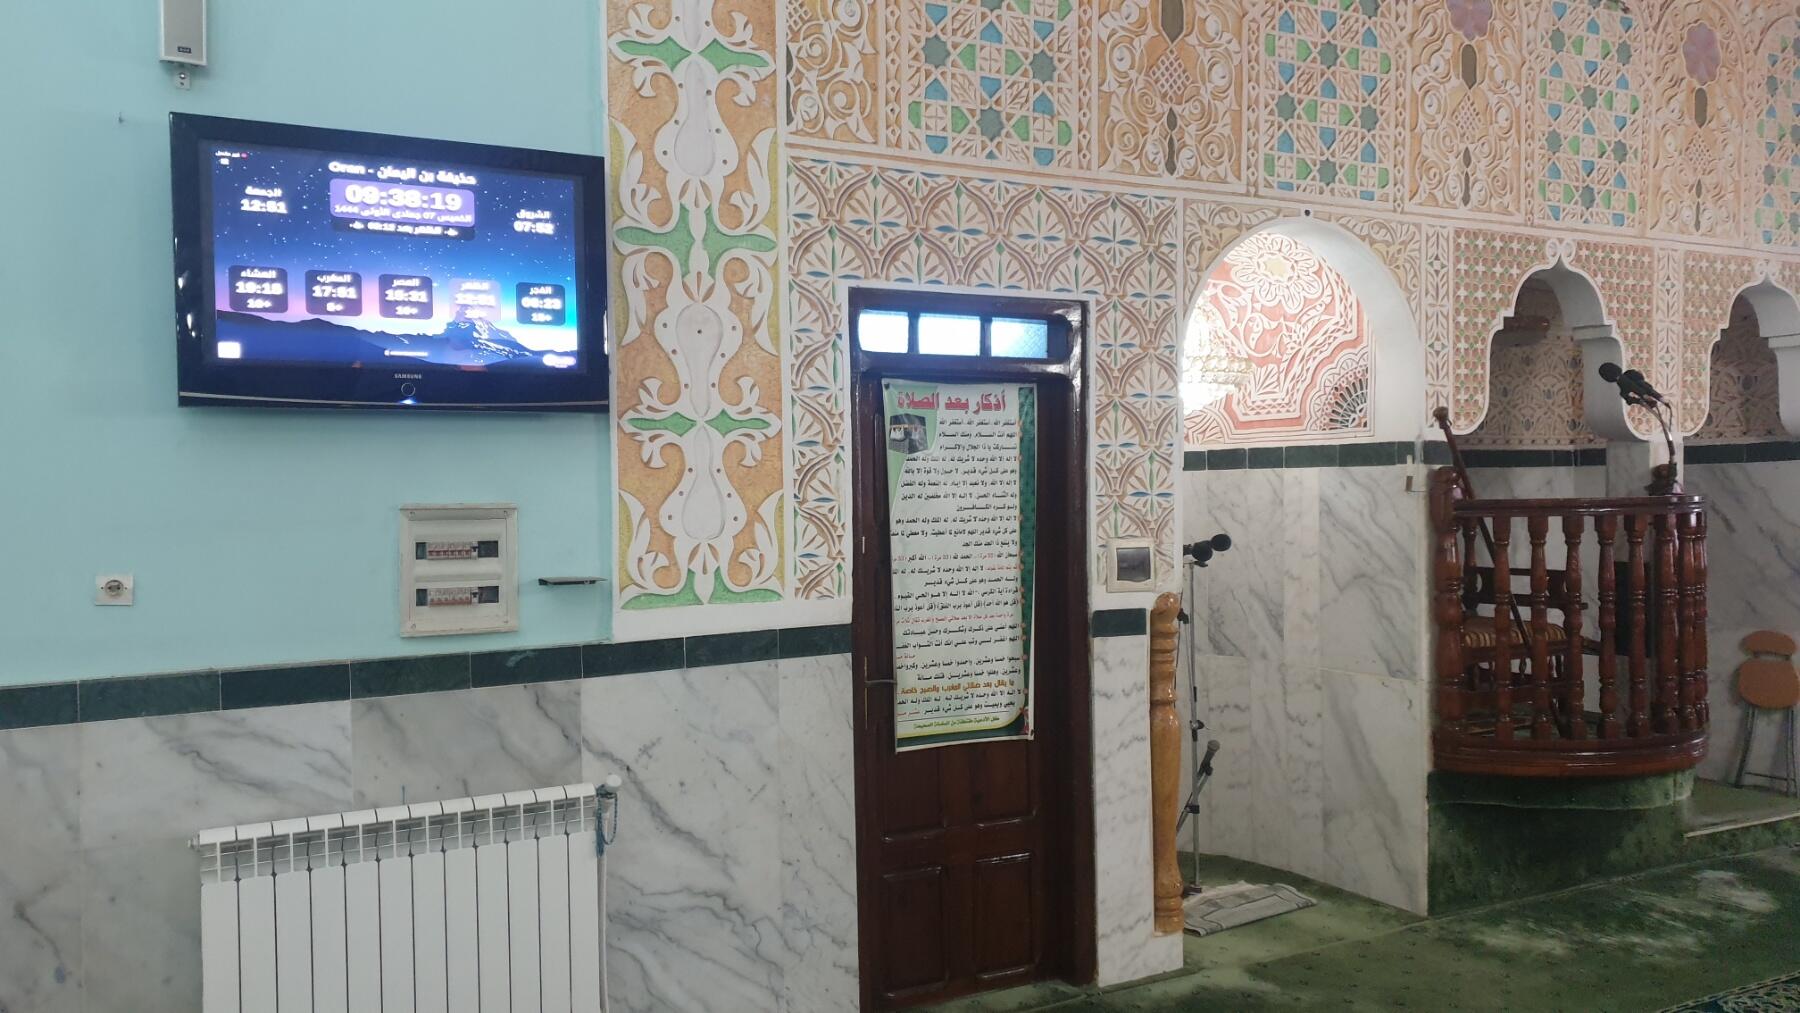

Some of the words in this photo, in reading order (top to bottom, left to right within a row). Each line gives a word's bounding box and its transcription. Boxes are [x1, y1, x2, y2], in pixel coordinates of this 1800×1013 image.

[328, 160, 366, 175] Oran
[418, 170, 435, 183] بن
[897, 391, 940, 410] الصلاة
[944, 396, 970, 415] بعد
[972, 388, 1006, 415] أذكار
